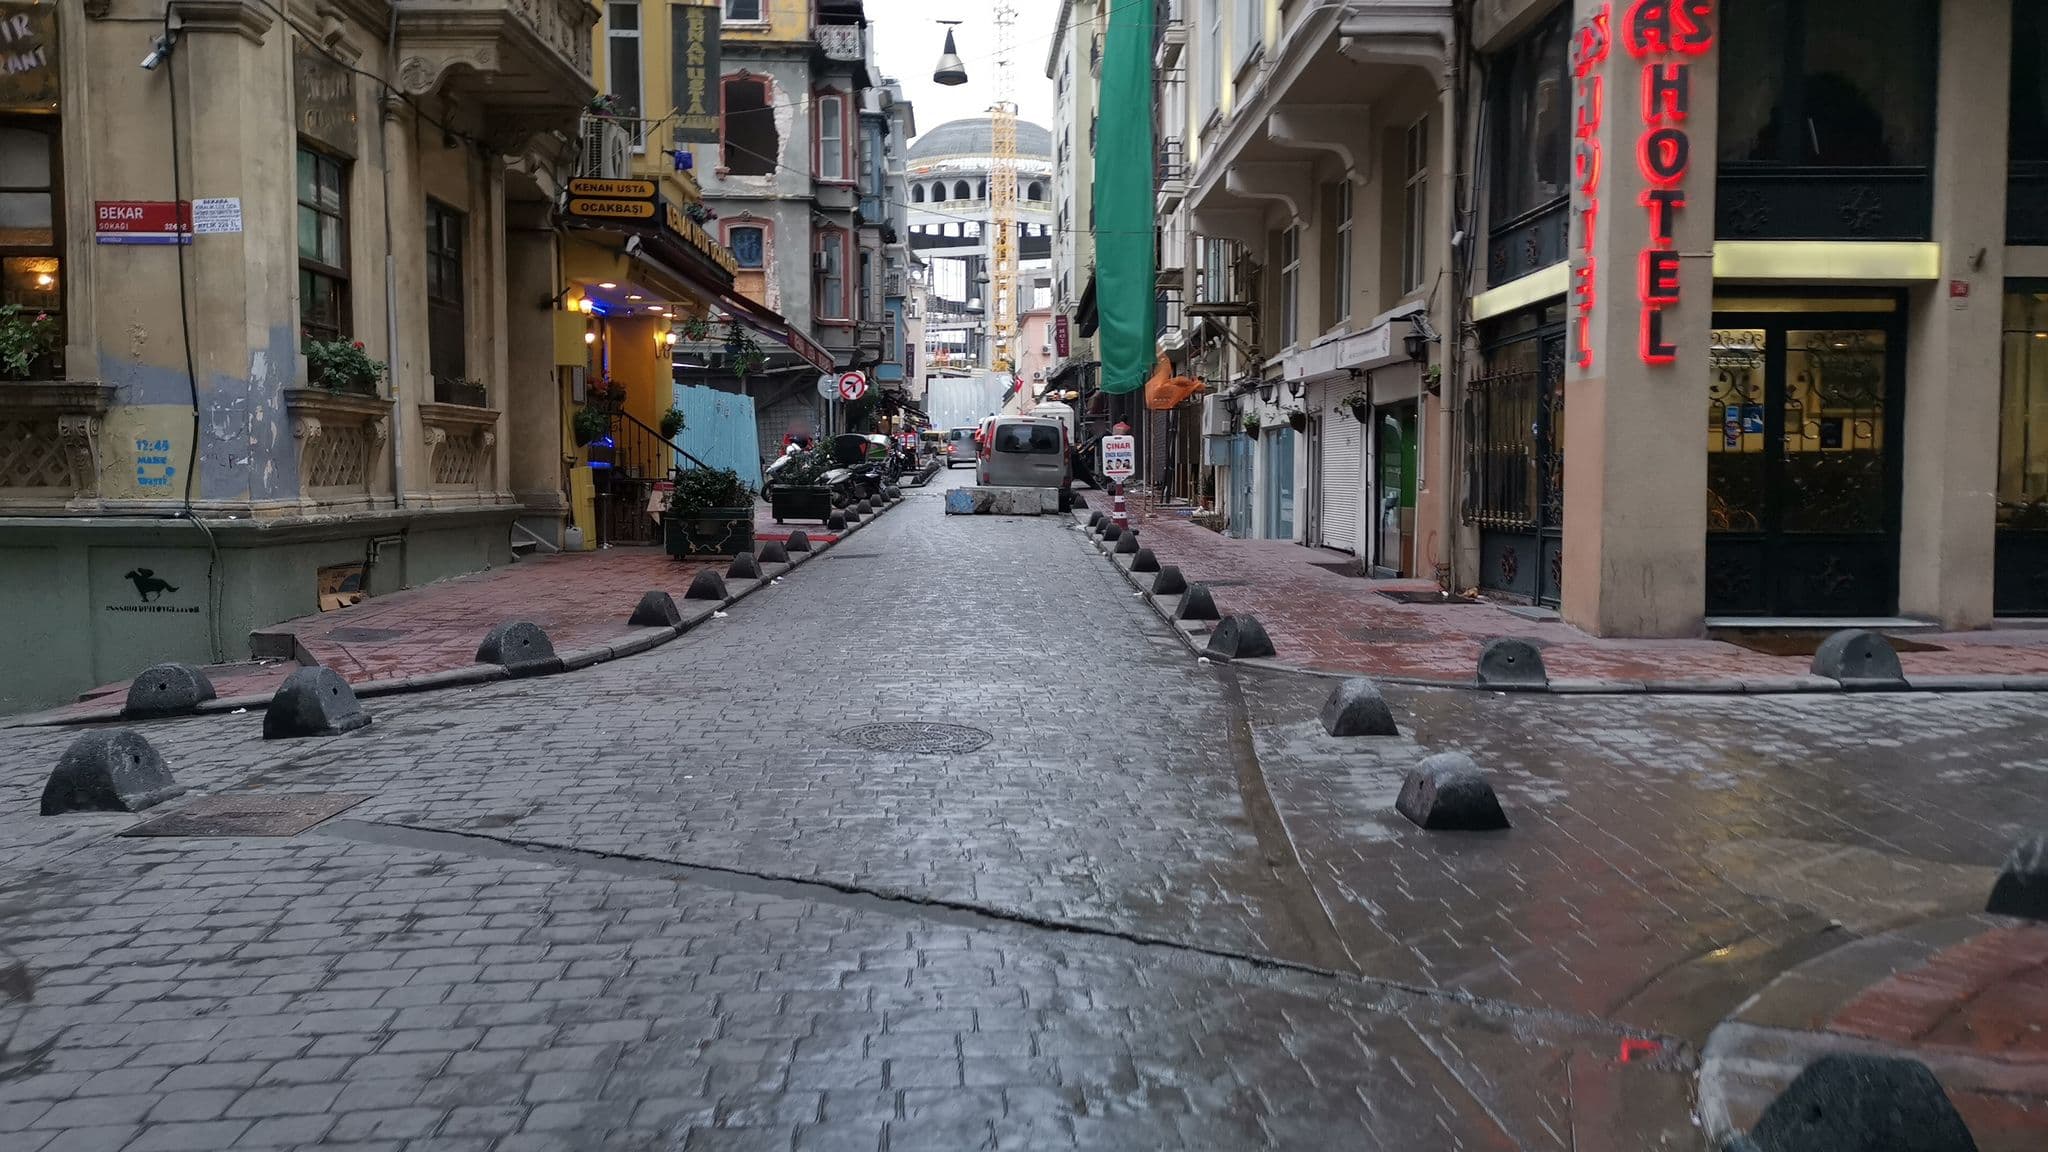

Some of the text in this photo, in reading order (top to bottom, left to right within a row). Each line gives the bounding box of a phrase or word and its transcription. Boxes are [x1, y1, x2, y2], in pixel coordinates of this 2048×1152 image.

[575, 183, 645, 193] KENAN USTA
[99, 206, 144, 220] BEKAR
[1637, 62, 1690, 365] HOTEL
